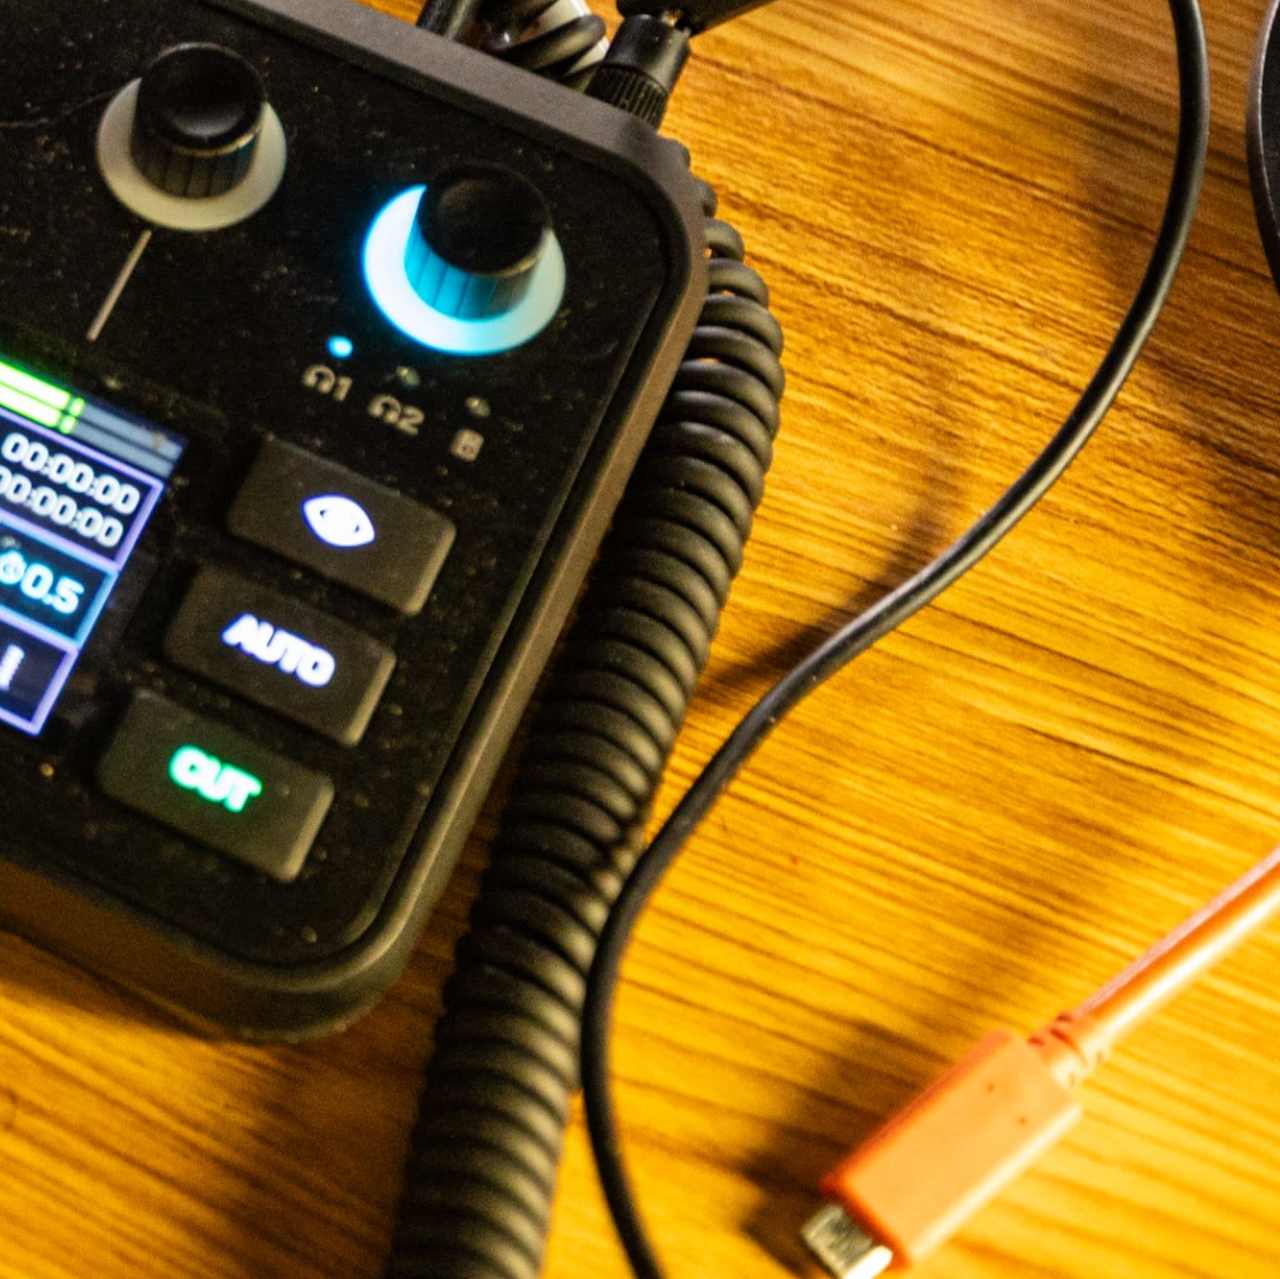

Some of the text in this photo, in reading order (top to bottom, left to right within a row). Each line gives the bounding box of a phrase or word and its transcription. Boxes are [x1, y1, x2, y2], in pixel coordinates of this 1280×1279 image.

[1, 432, 140, 515] 00:00:00
[21, 562, 85, 614] 0.5
[221, 613, 336, 687] AUTO
